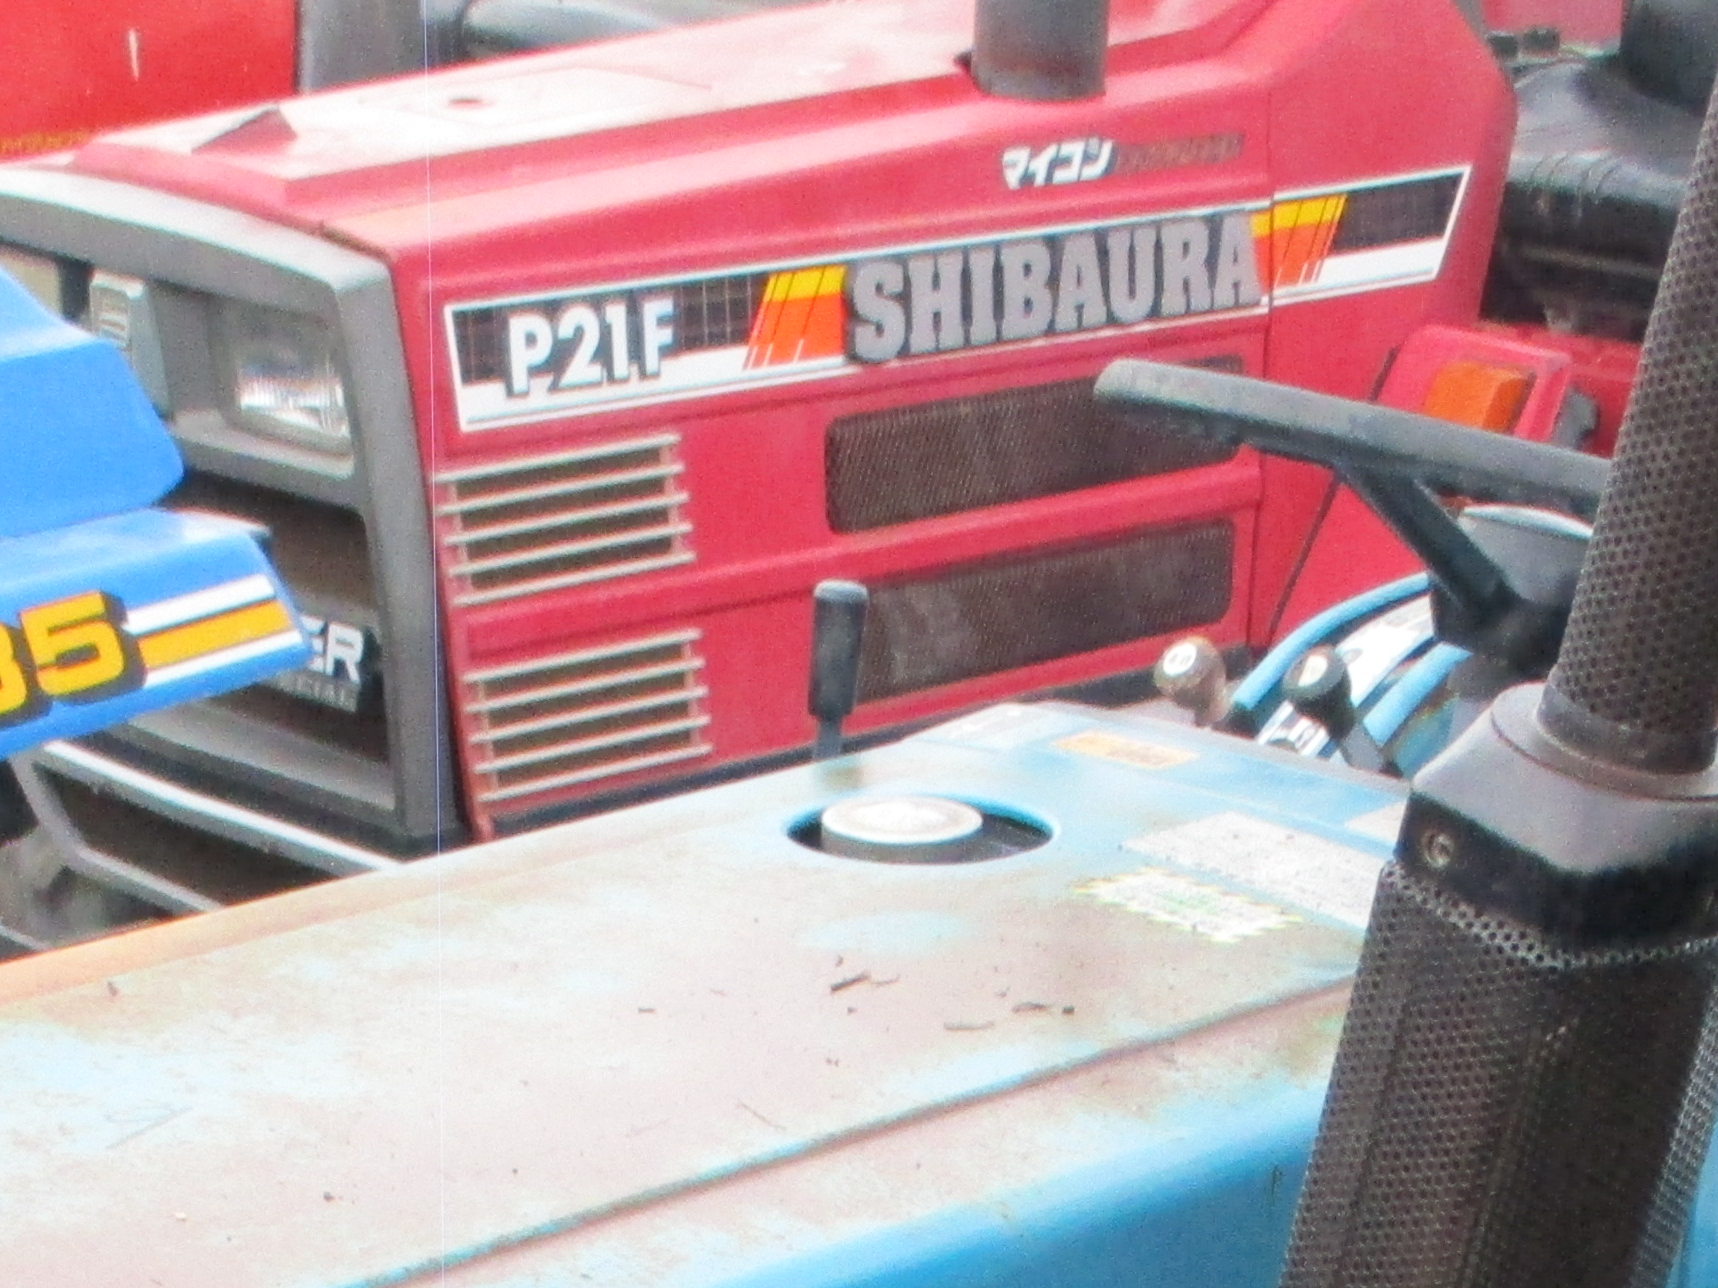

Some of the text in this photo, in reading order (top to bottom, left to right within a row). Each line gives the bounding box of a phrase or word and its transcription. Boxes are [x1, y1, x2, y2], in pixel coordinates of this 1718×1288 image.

[1001, 135, 1119, 190] マイコン
[853, 212, 1263, 364] SHIBAURA
[506, 294, 676, 396] P21F
